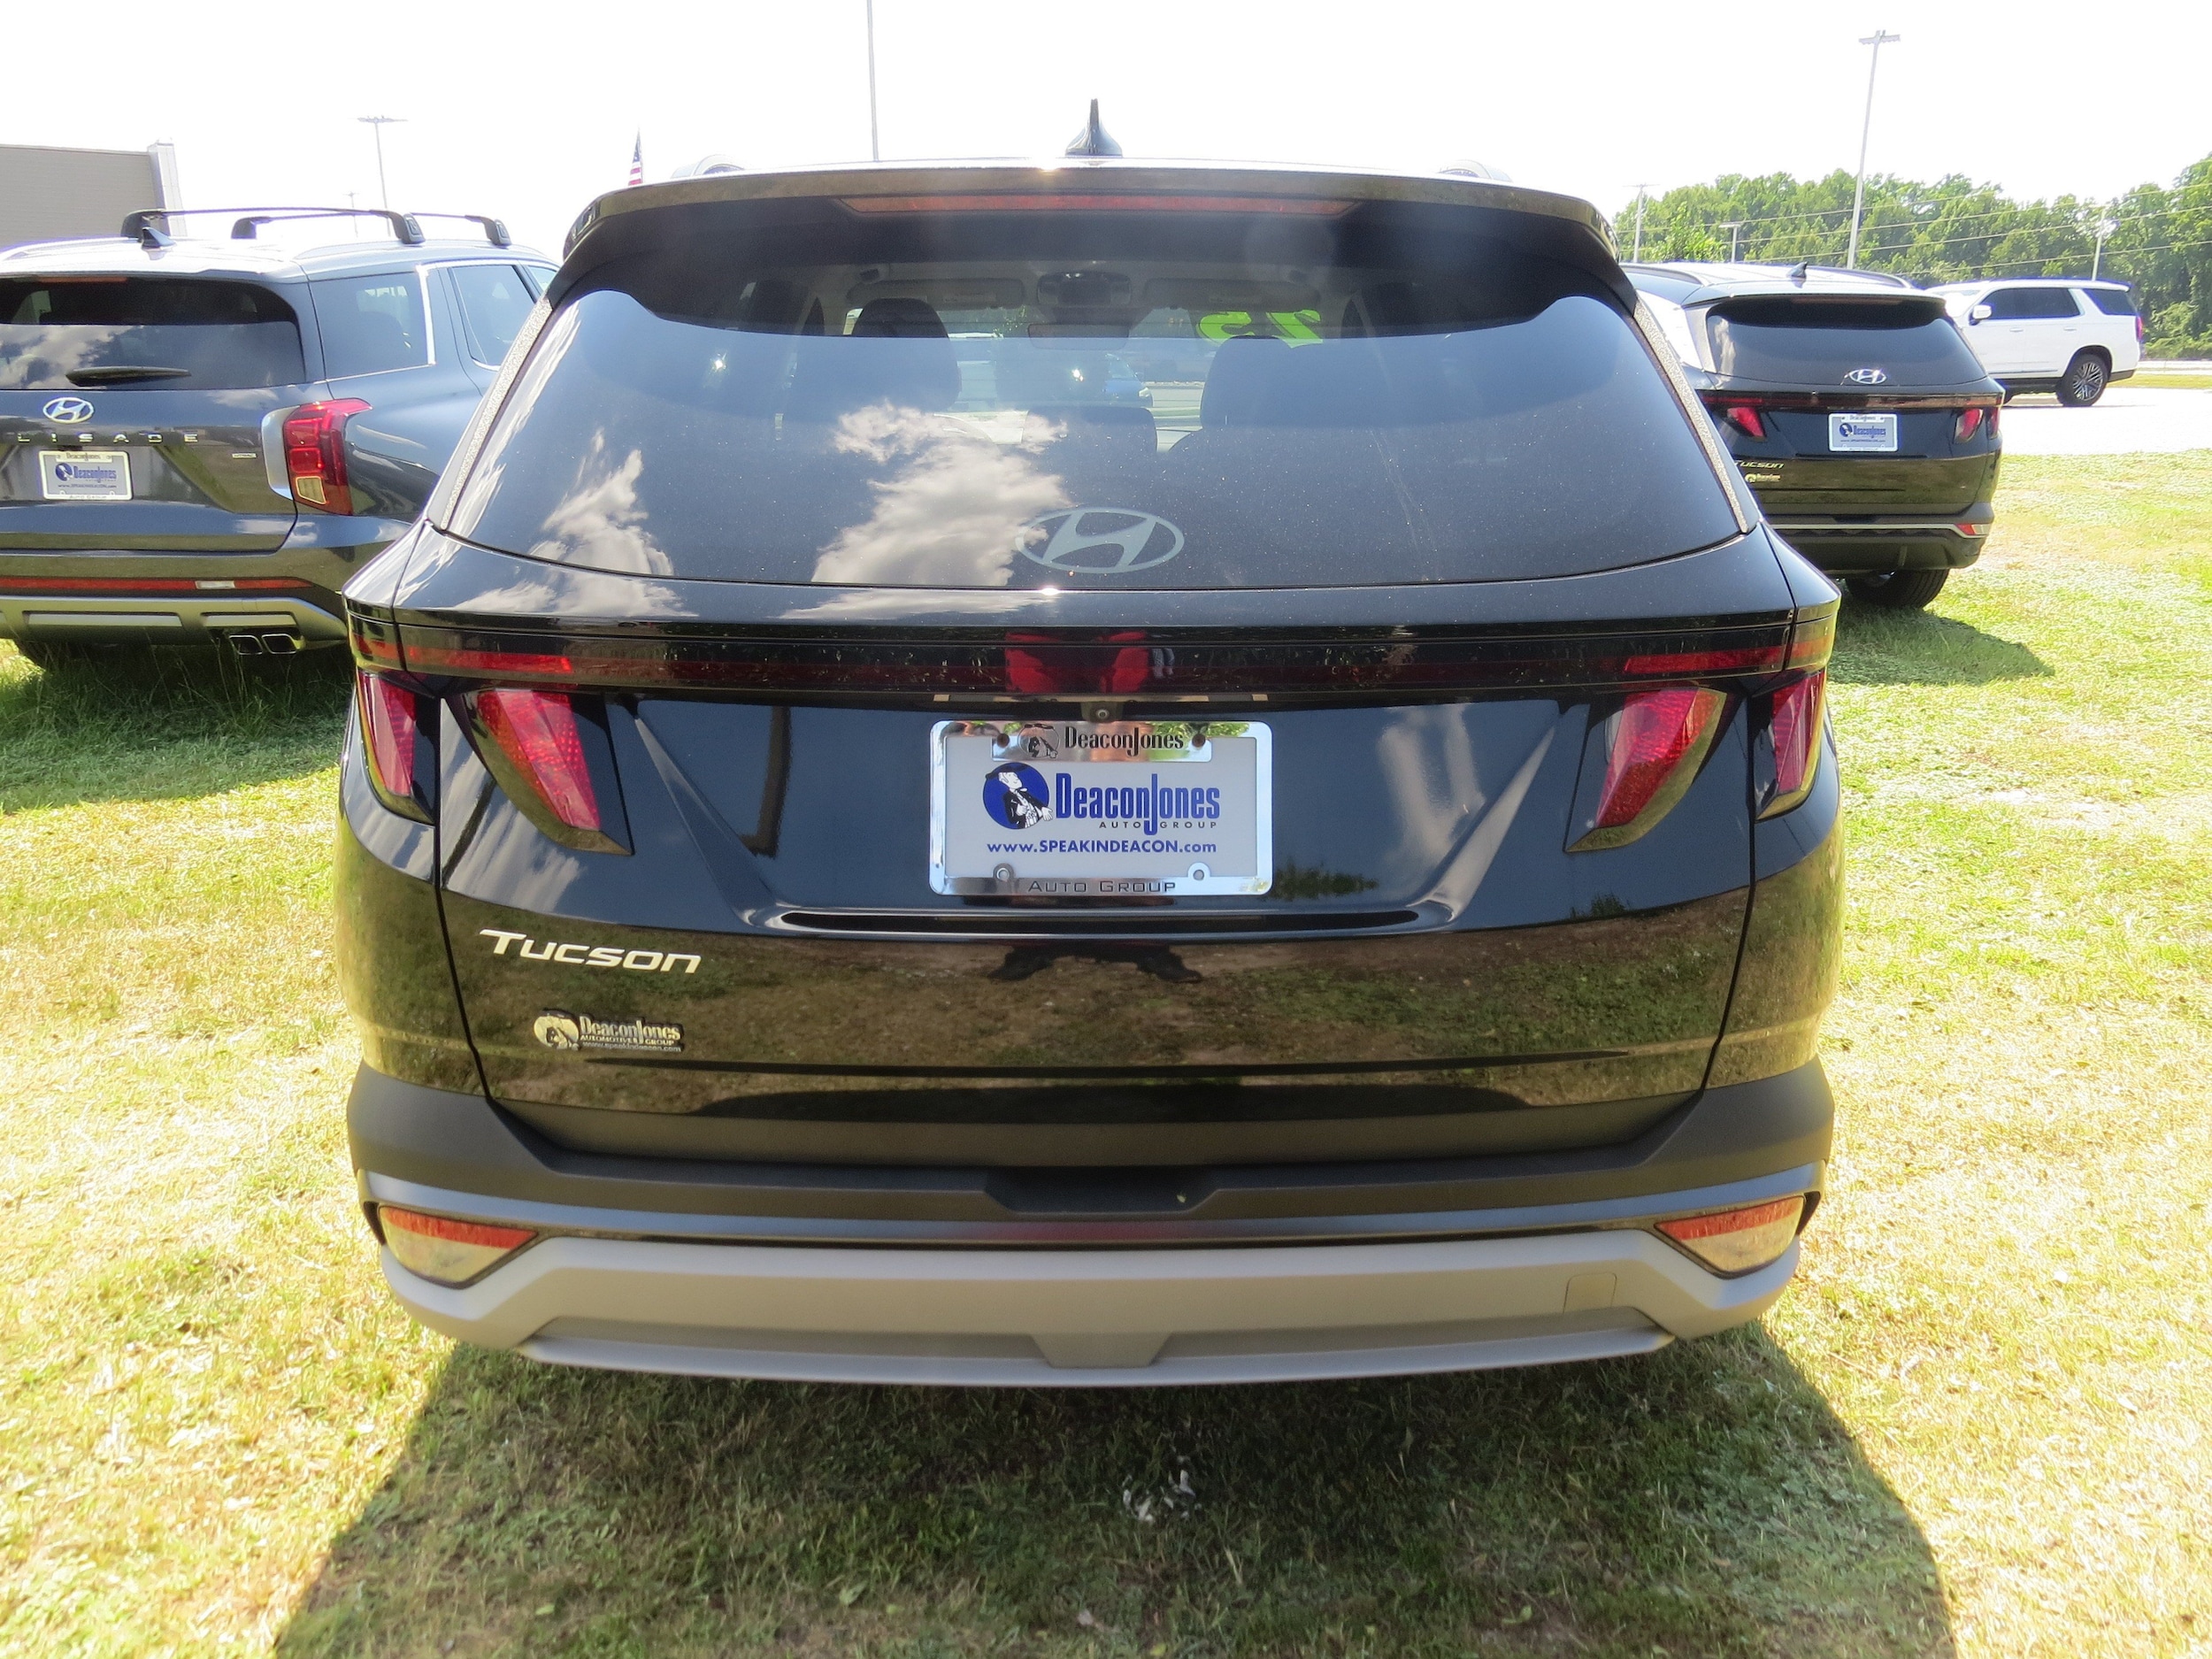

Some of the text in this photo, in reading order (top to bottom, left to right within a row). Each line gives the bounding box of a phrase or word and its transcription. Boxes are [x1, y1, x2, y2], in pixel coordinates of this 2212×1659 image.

[1064, 726, 1184, 757] DeaconJones
[1056, 773, 1220, 835] DeaconJones
[987, 840, 1217, 853] www.SPEAKINDEACON.com
[579, 1016, 681, 1044] DeaconJones
